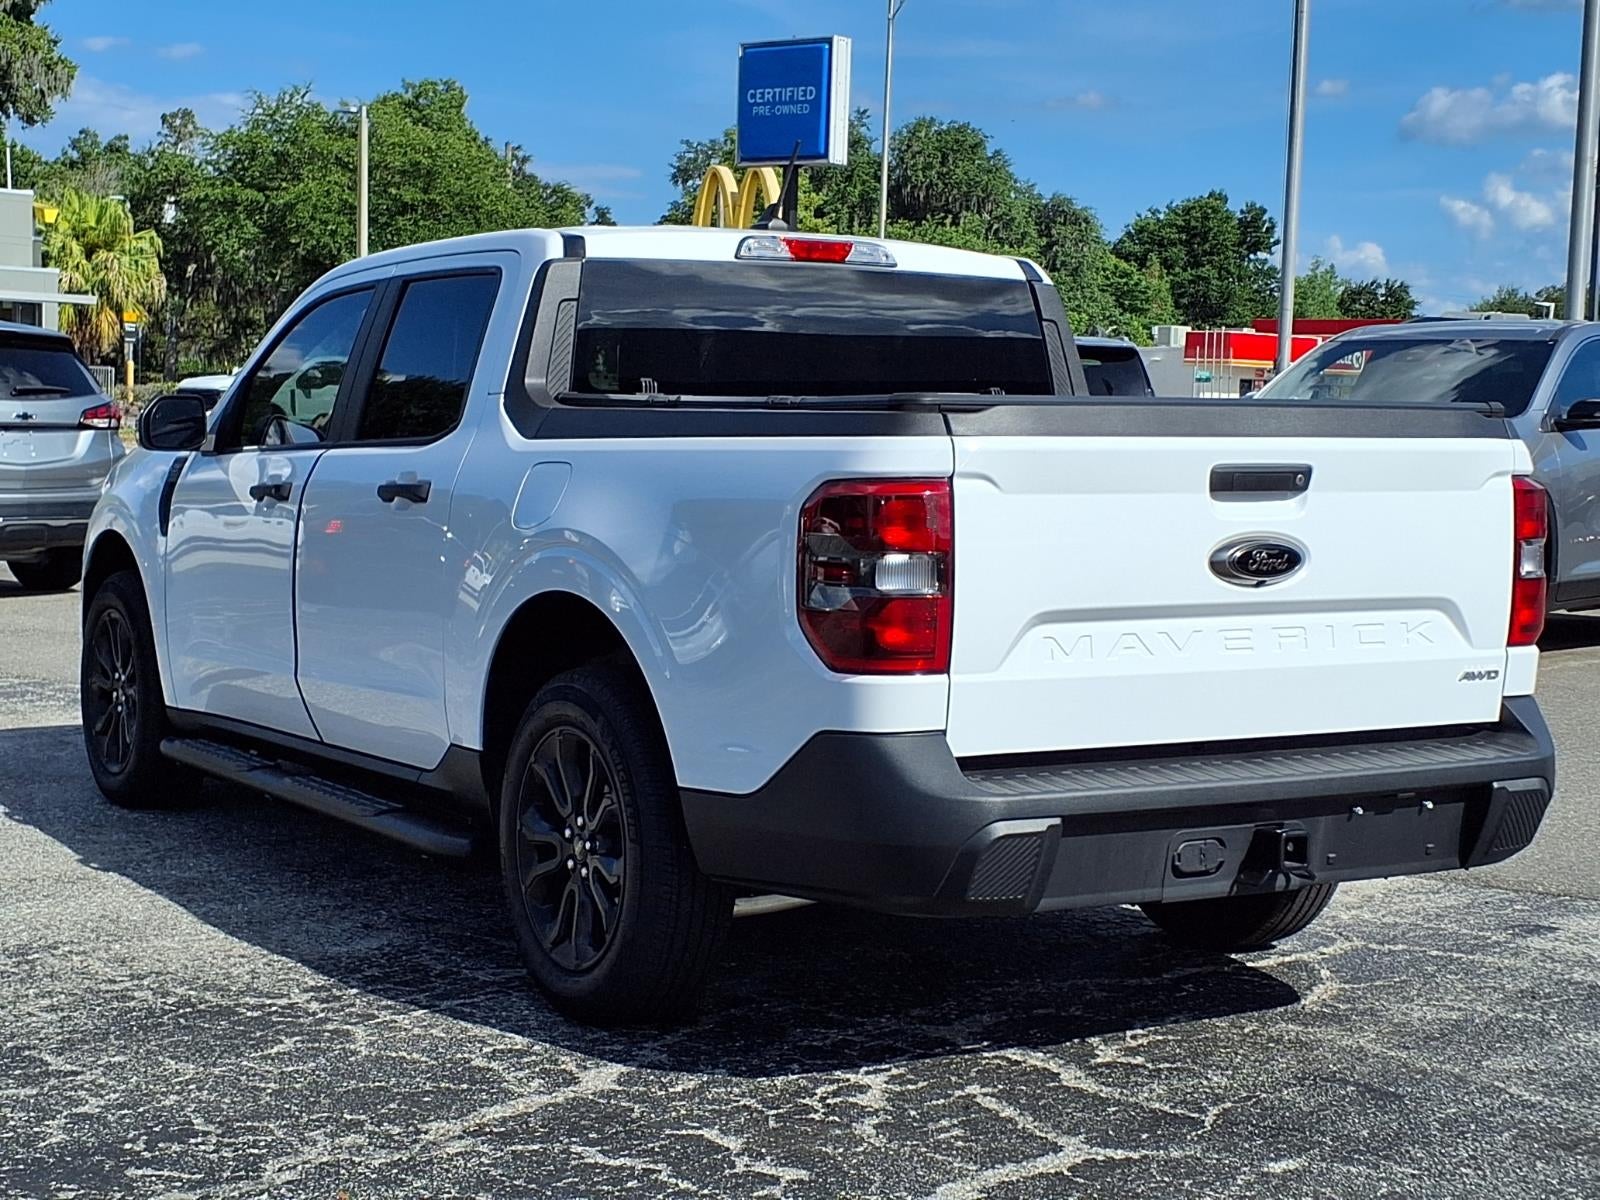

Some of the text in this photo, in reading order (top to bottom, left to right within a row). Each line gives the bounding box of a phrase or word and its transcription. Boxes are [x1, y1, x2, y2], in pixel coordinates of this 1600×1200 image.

[747, 86, 816, 103] CERTIFIED
[752, 104, 810, 116] PRE-OWNED
[1248, 549, 1288, 571] Ford
[1042, 620, 1434, 661] MAVERICK
[1458, 670, 1499, 682] AWD
